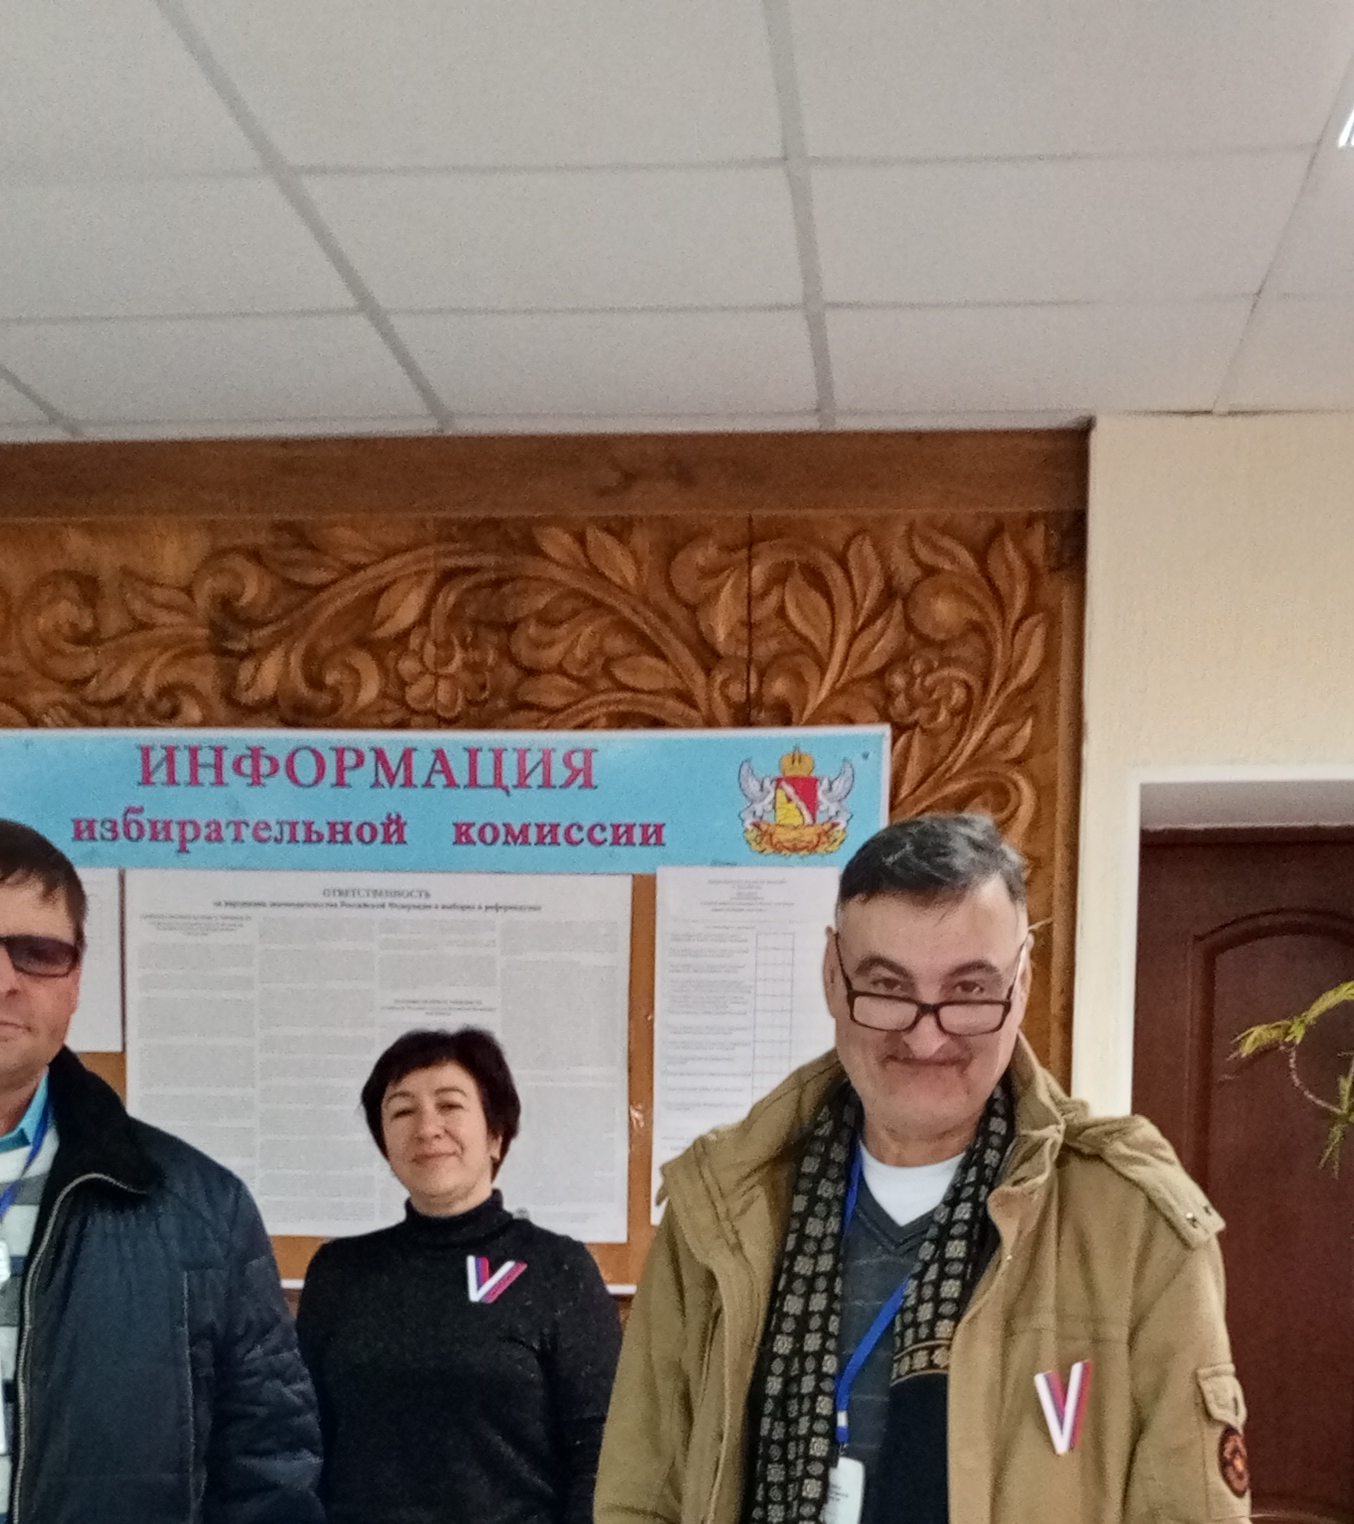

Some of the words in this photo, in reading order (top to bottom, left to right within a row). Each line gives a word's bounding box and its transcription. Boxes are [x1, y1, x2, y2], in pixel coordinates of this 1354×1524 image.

[137, 744, 598, 797] ИНФОРМАЦИЯ
[71, 806, 408, 853] избирательной
[453, 815, 666, 847] комиссии
